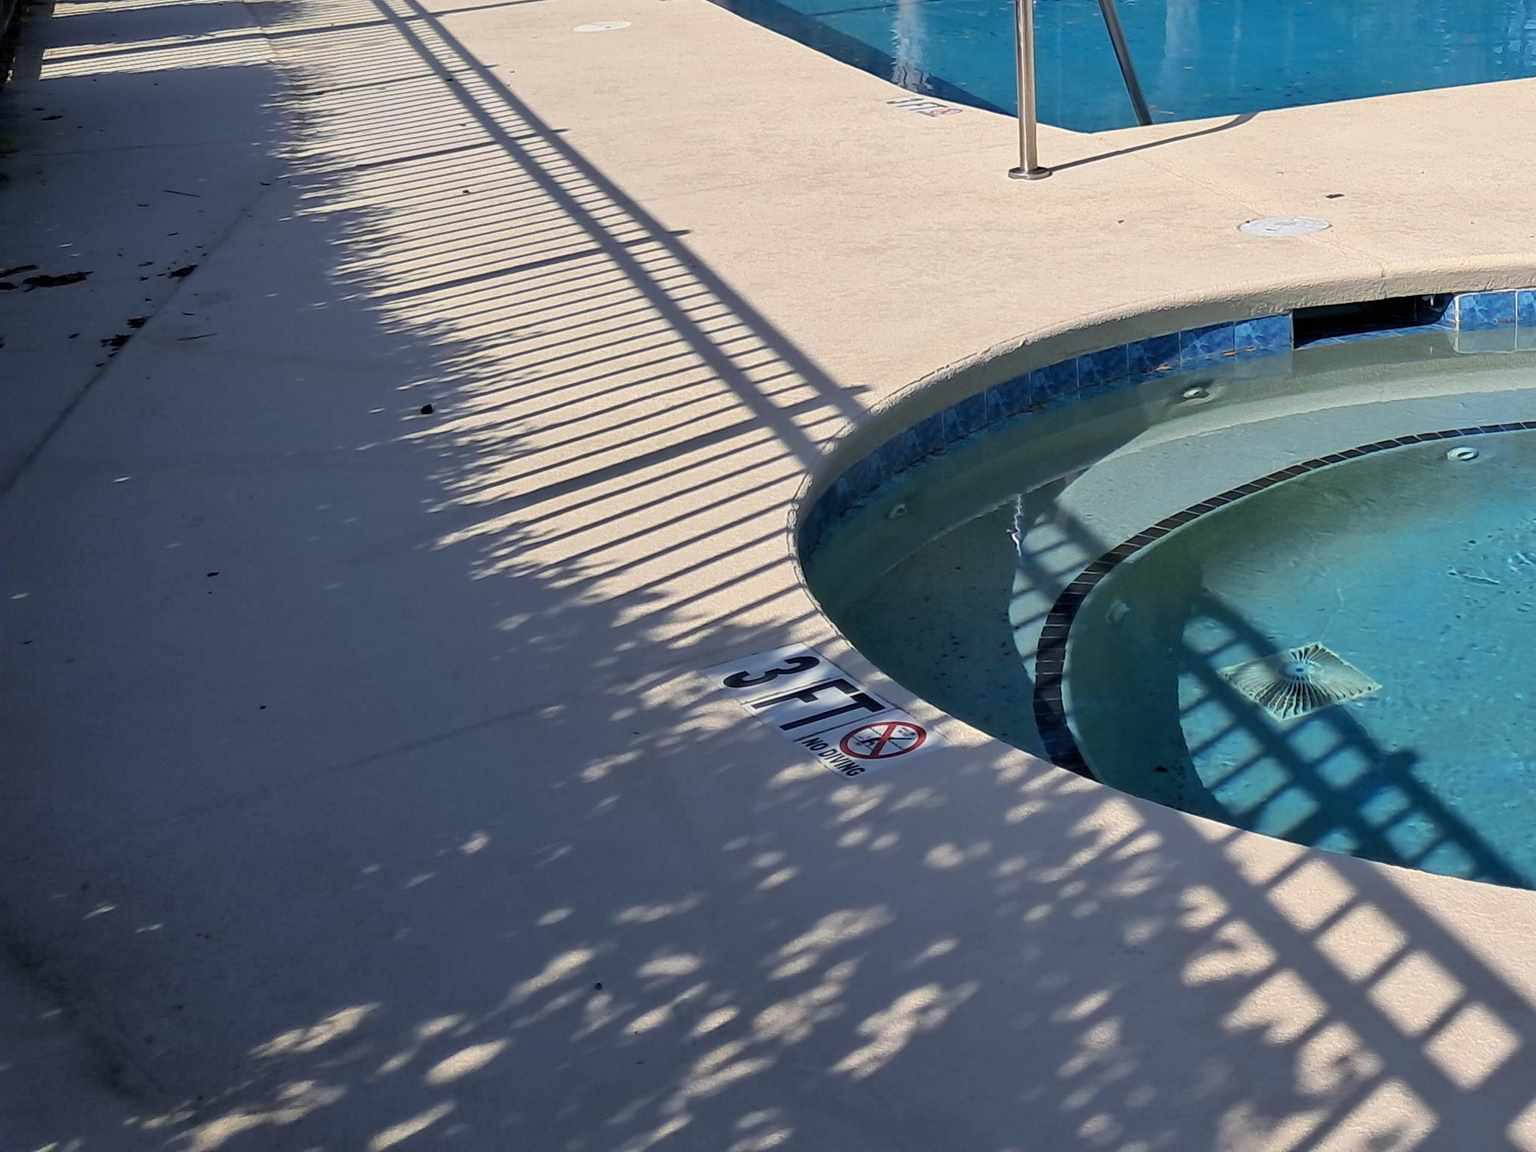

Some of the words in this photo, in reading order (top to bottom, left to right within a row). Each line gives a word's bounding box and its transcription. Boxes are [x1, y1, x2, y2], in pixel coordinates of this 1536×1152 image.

[722, 655, 820, 689] 3
[749, 678, 886, 732] FT
[801, 737, 829, 751] NO
[818, 748, 866, 777] DIVING
